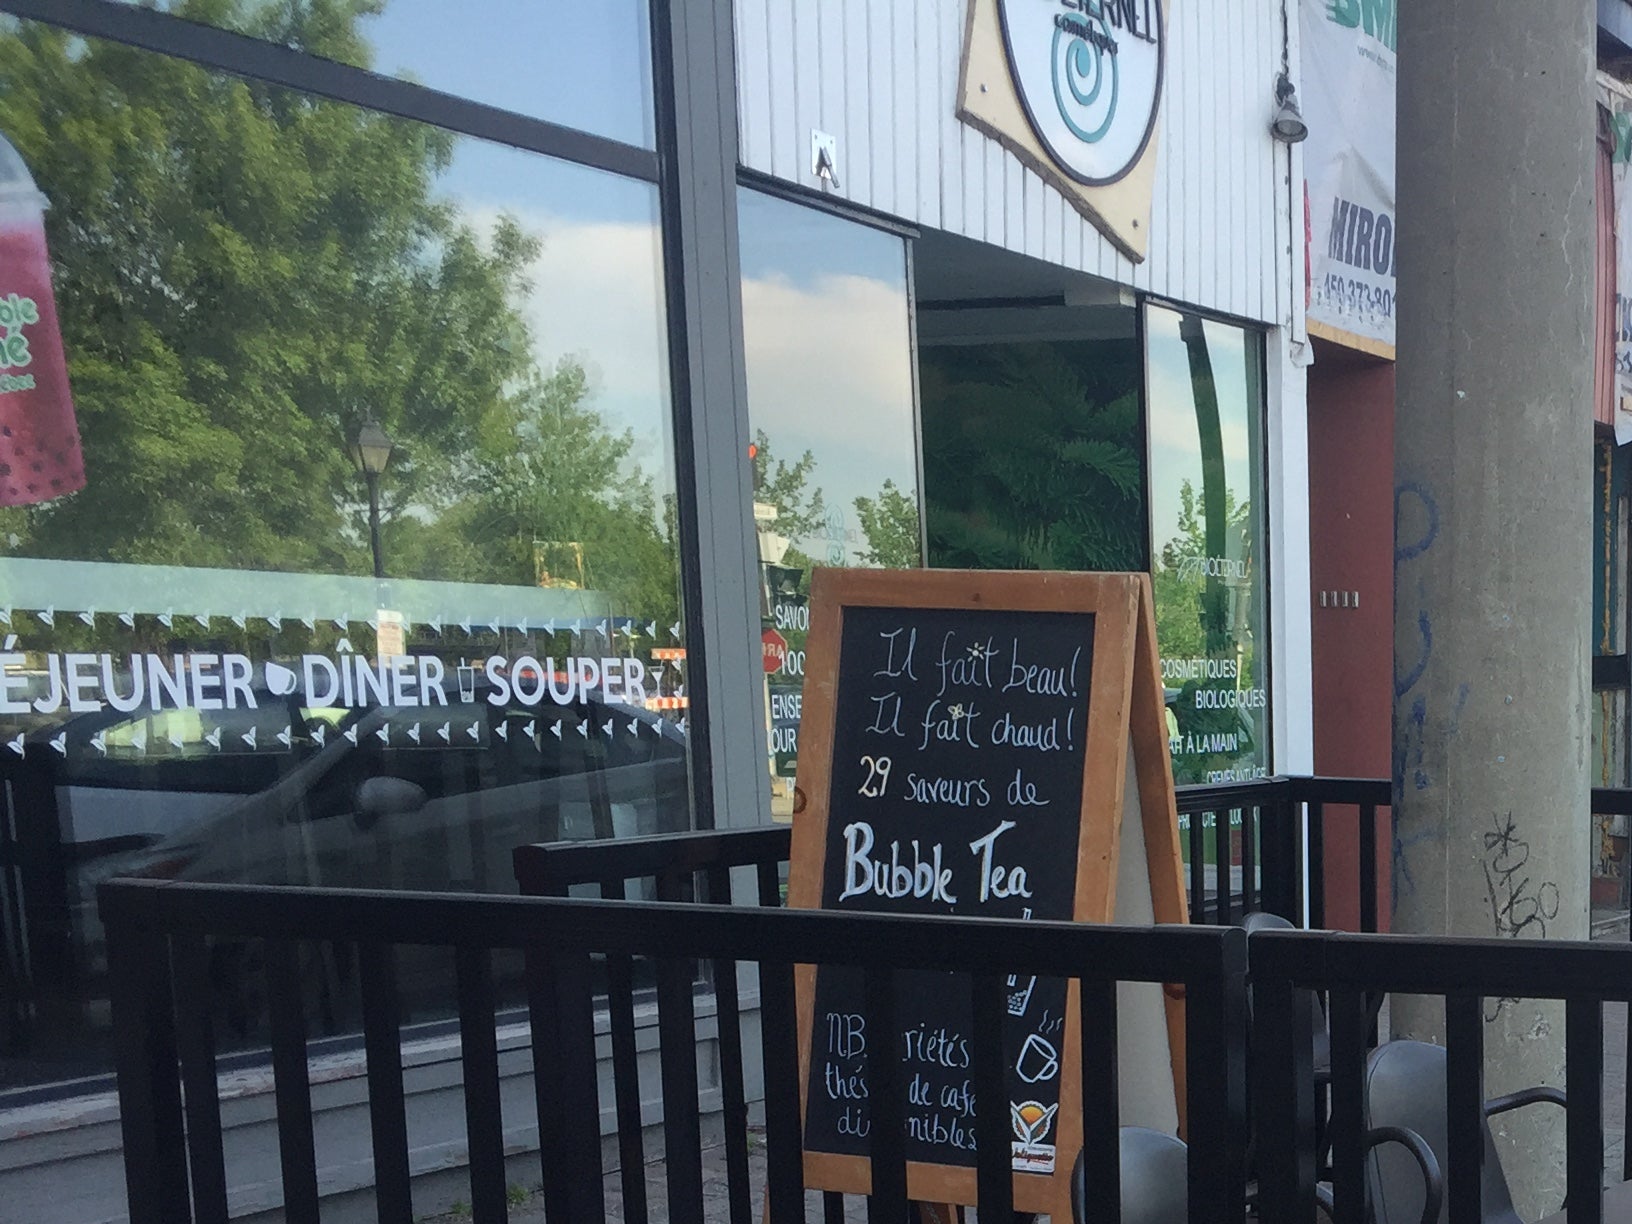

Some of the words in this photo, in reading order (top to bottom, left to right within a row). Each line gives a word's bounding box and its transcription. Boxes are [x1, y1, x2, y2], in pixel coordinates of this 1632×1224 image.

[1328, 195, 1397, 277] MIRO
[302, 638, 449, 709] DÎNER
[486, 655, 646, 706] SOUPER
[873, 627, 919, 681] Il
[935, 630, 1000, 697] fait
[1001, 637, 1082, 697] beau!
[1159, 656, 1237, 679] COSMÉTIQUES
[865, 692, 906, 737] Il
[918, 699, 982, 750] fait
[1195, 688, 1267, 710] BIOLOGIQUES
[1196, 734, 1209, 753] LA
[1211, 733, 1238, 751] MAIN
[857, 755, 893, 798] 29
[903, 772, 991, 807] saveurs
[1006, 768, 1051, 806] de
[838, 821, 958, 904] Bubble
[968, 819, 1033, 903] Tea
[901, 1022, 971, 1069] riétés
[908, 1073, 934, 1107] de
